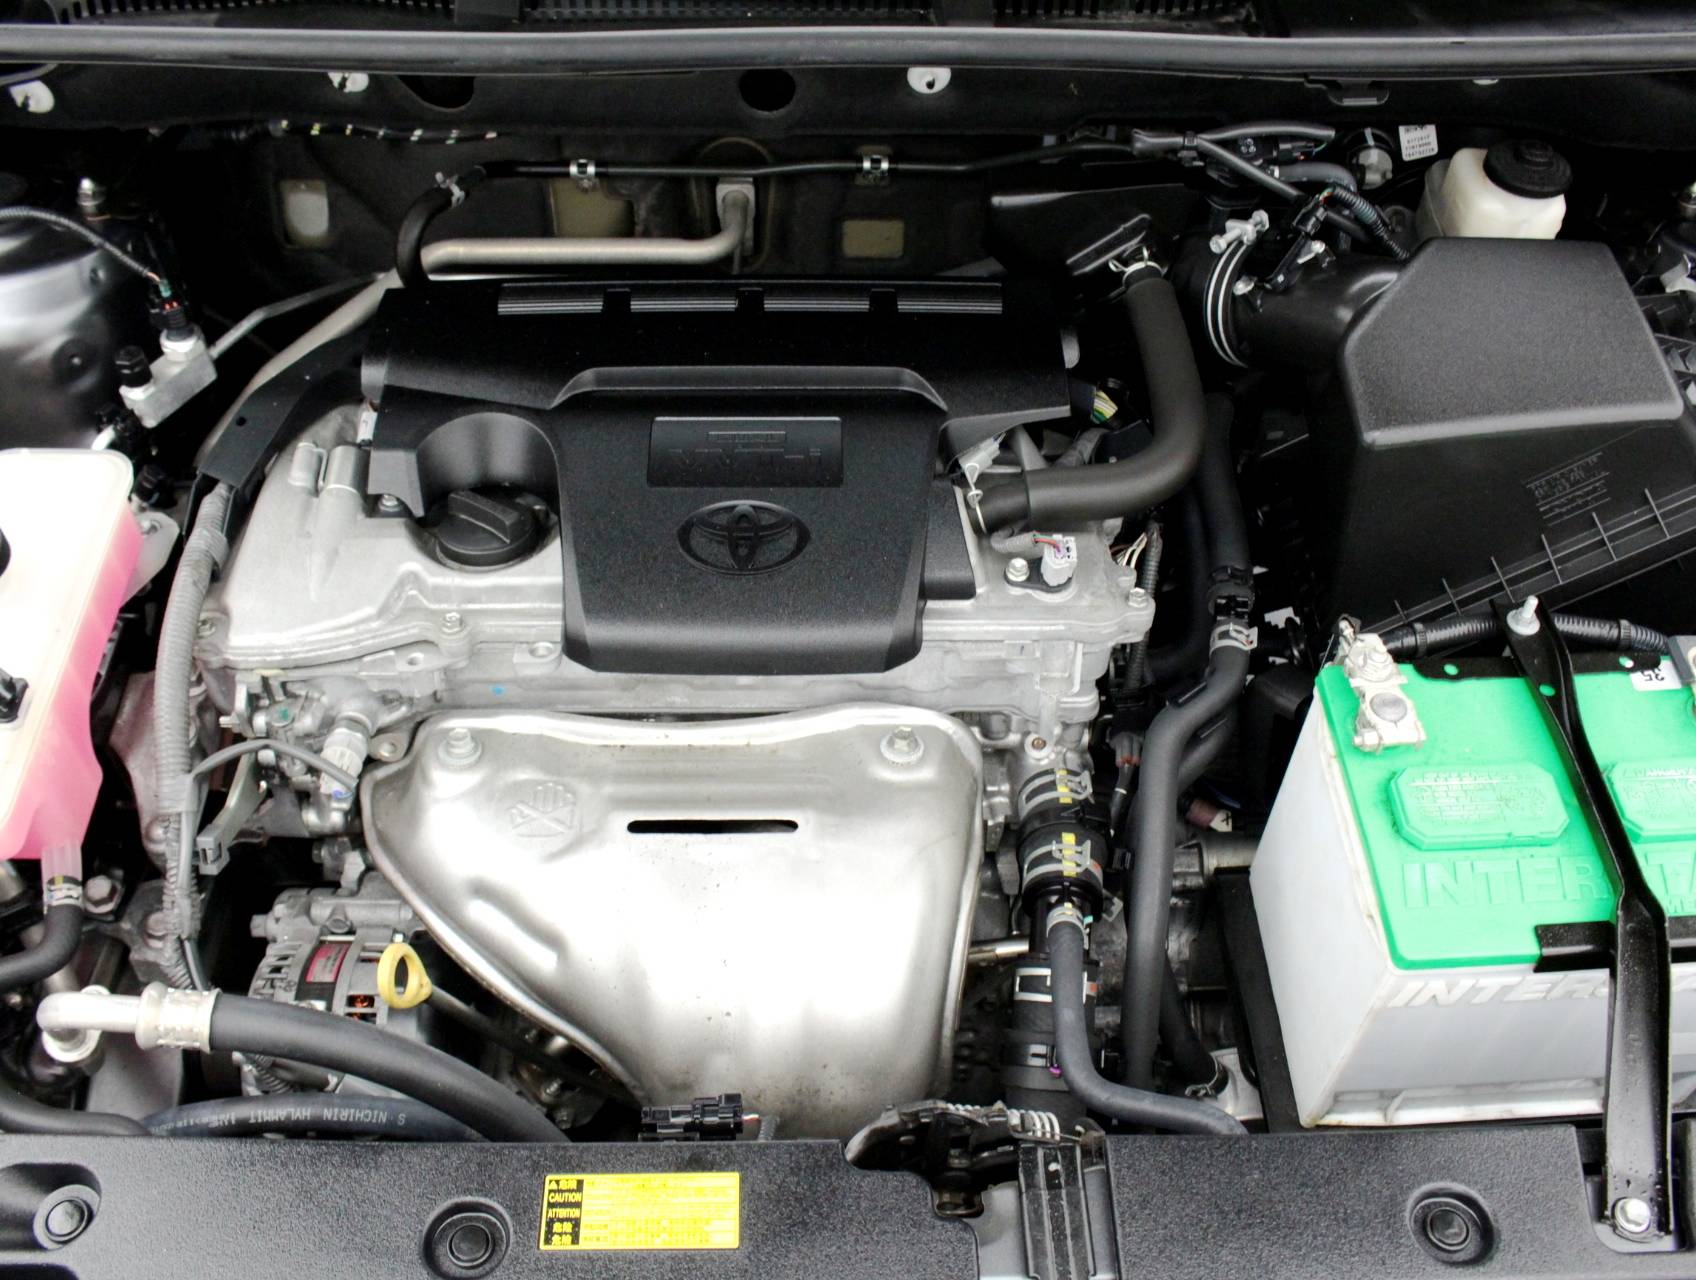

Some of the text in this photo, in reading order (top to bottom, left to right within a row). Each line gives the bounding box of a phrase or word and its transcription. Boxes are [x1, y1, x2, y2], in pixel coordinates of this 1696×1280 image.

[322, 1107, 388, 1124] NICHIRIN
[549, 1192, 582, 1203] CAUTION
[548, 1208, 580, 1218] ATTENTION
